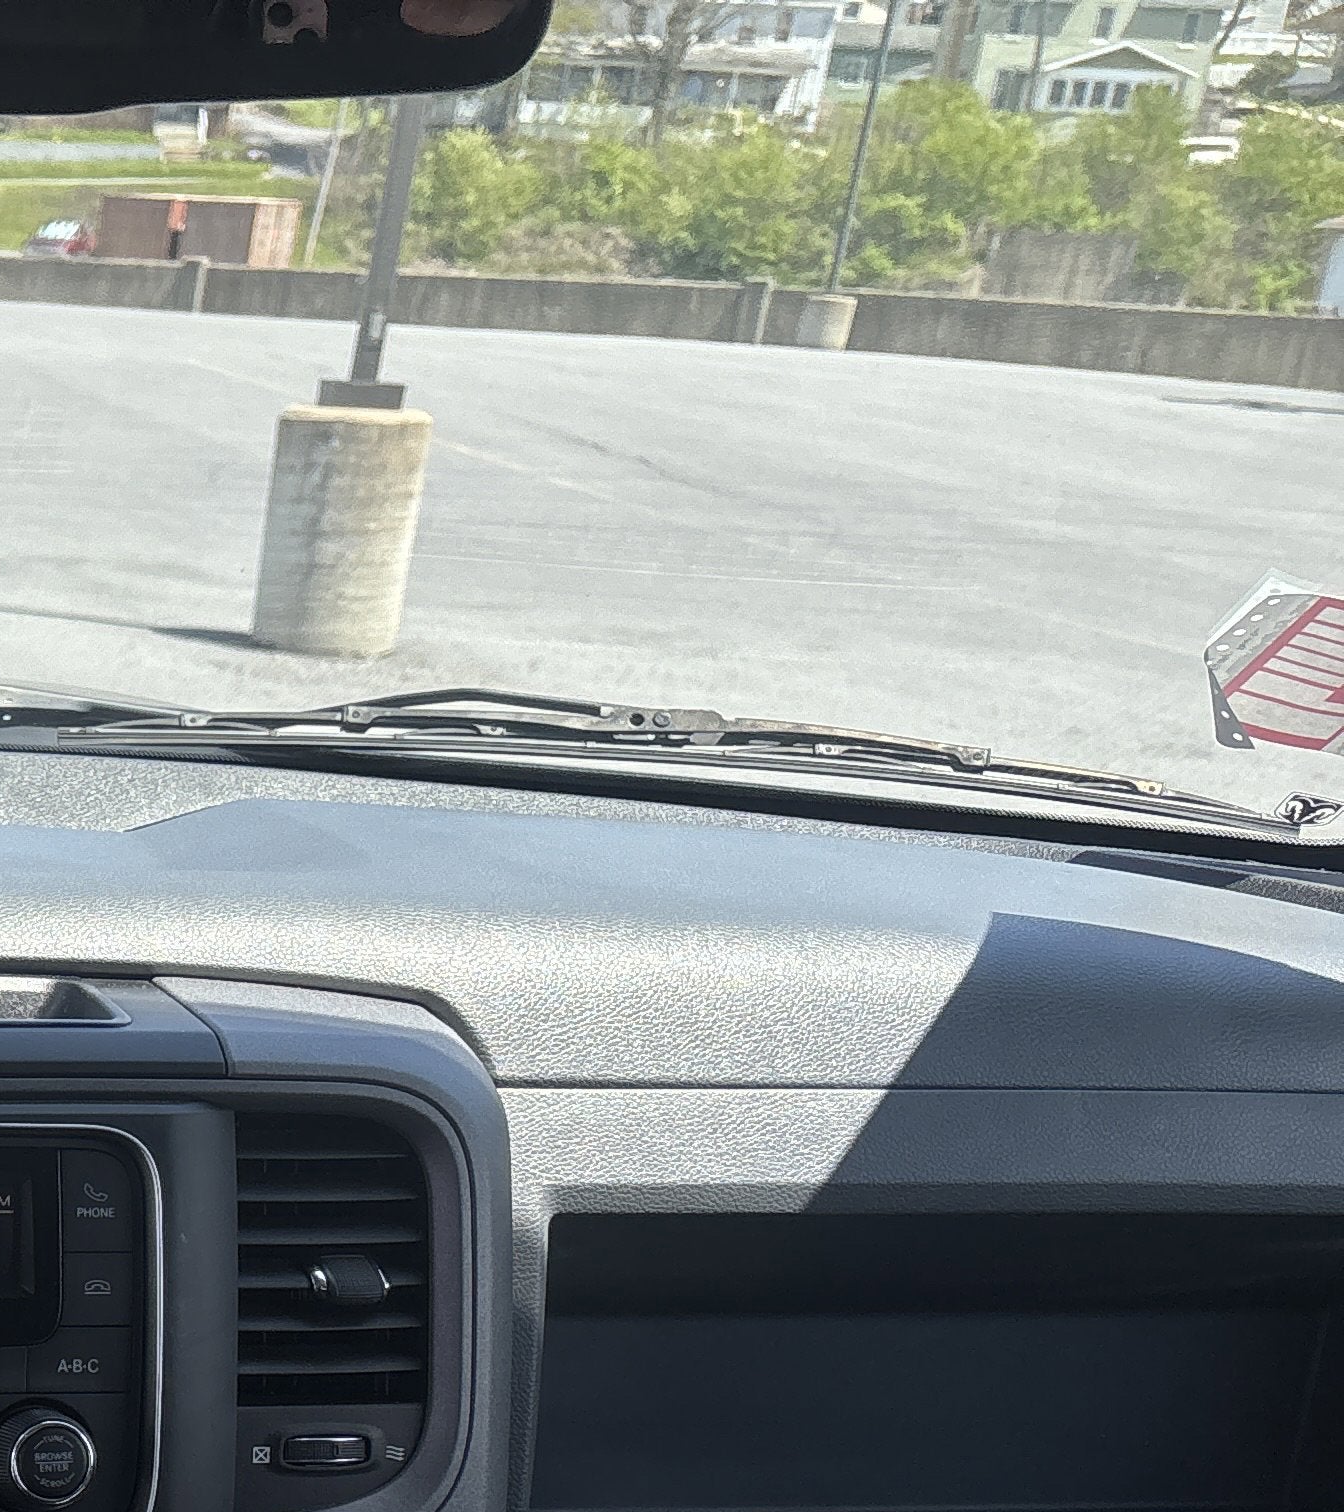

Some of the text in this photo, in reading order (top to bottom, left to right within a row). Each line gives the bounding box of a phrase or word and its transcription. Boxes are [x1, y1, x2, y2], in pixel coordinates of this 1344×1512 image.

[76, 1207, 116, 1218] PHONE
[34, 1452, 73, 1461] BROWSE
[39, 1463, 70, 1473] ENTER
